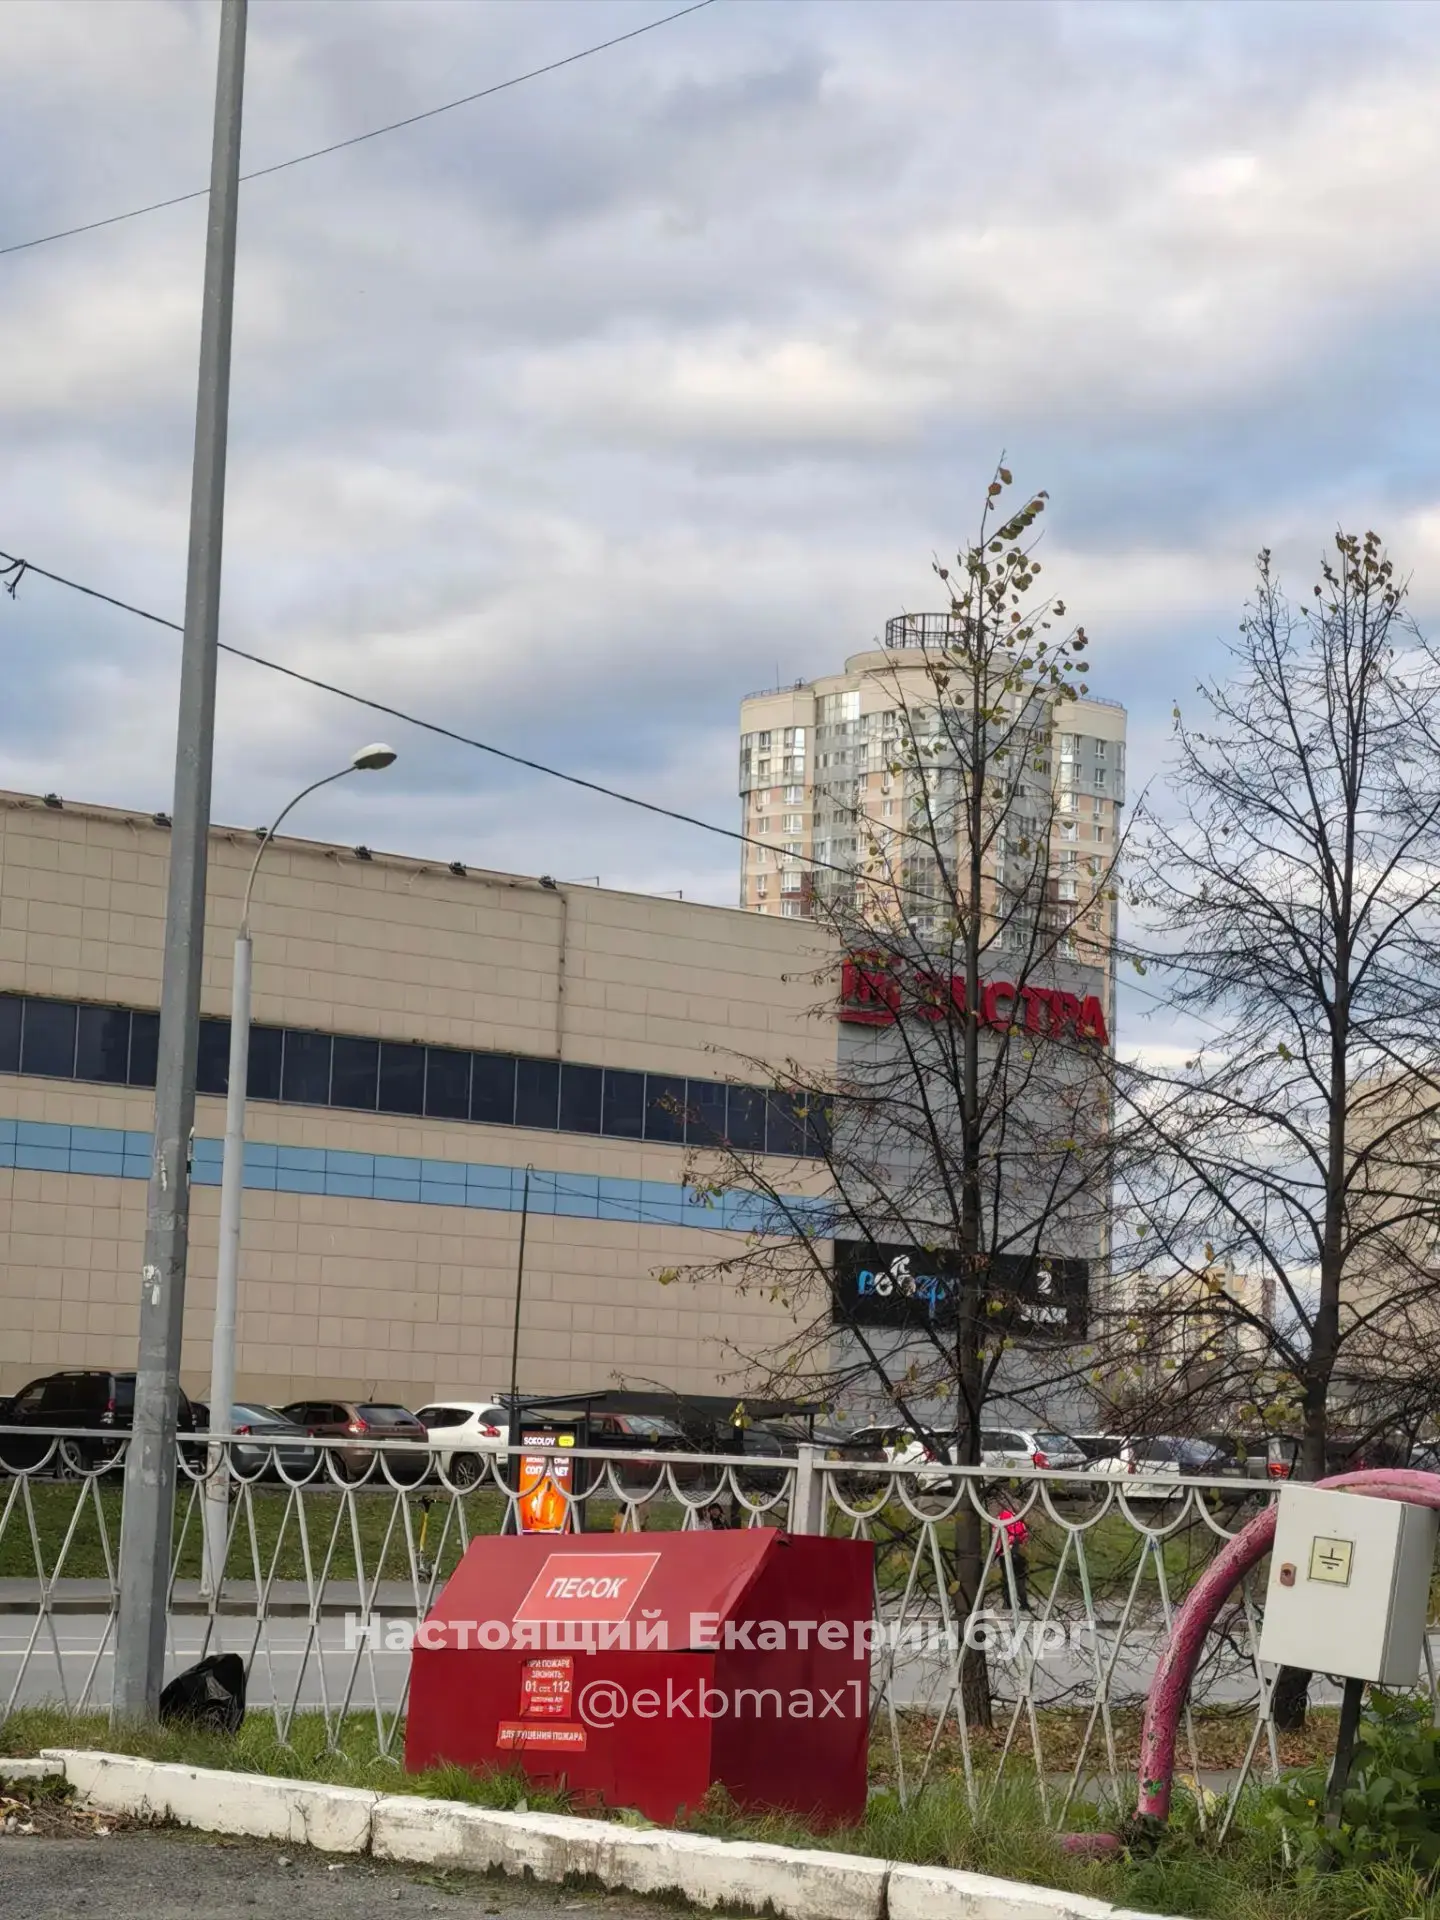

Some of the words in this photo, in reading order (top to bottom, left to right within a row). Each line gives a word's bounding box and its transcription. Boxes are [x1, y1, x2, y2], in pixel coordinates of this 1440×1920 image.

[523, 1436, 556, 1446] SOKOLOV
[545, 1577, 628, 1599] ПЕСОК
[542, 1658, 570, 1669] ПОЖАРЕ
[552, 1680, 570, 1693] 112
[552, 1731, 584, 1742] ПОЖАРА
